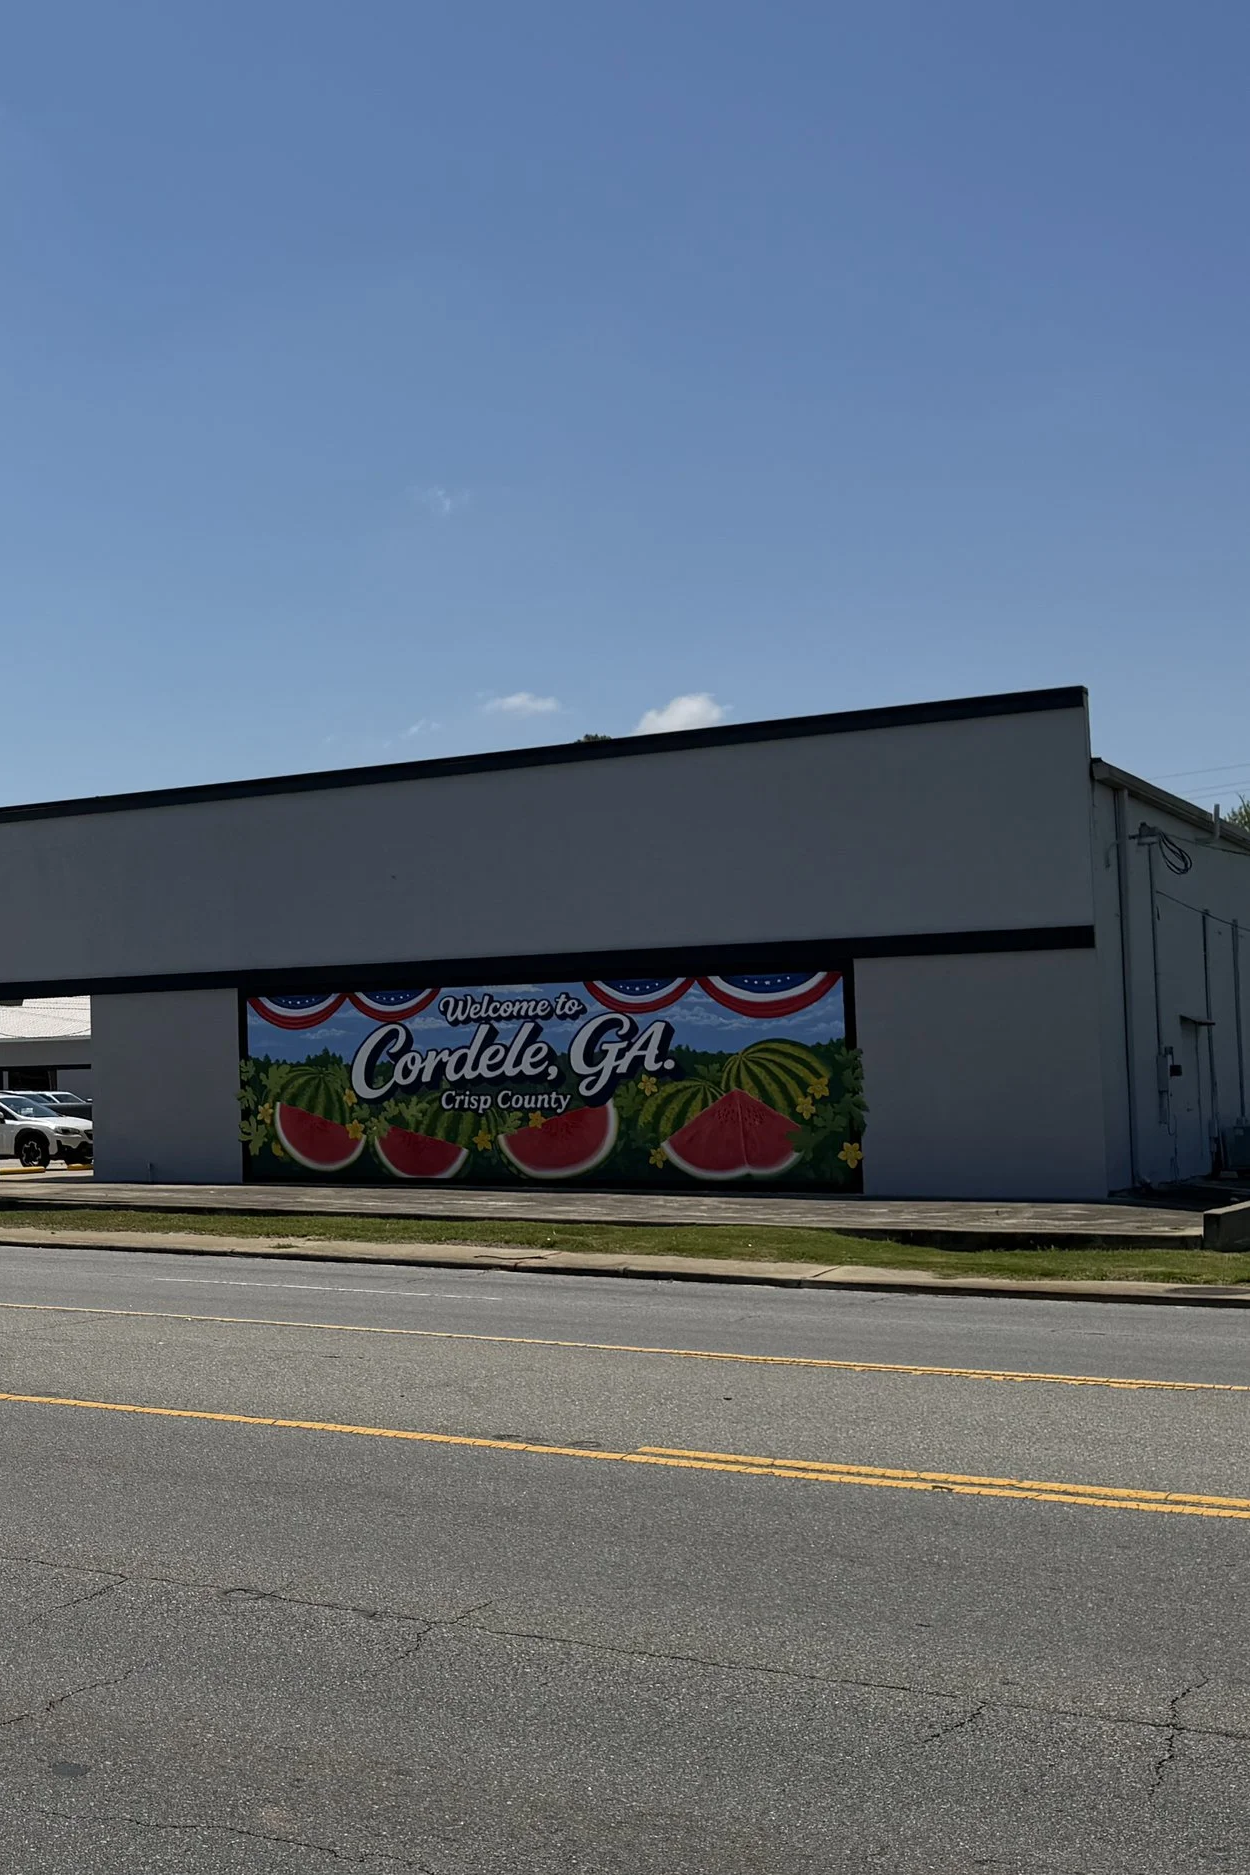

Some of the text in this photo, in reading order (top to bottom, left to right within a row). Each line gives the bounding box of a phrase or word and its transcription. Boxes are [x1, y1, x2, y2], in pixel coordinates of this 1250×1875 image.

[440, 993, 583, 1022] Welcome to
[352, 1012, 676, 1099] Cordele, GA.
[441, 1089, 571, 1113] Crisp County
